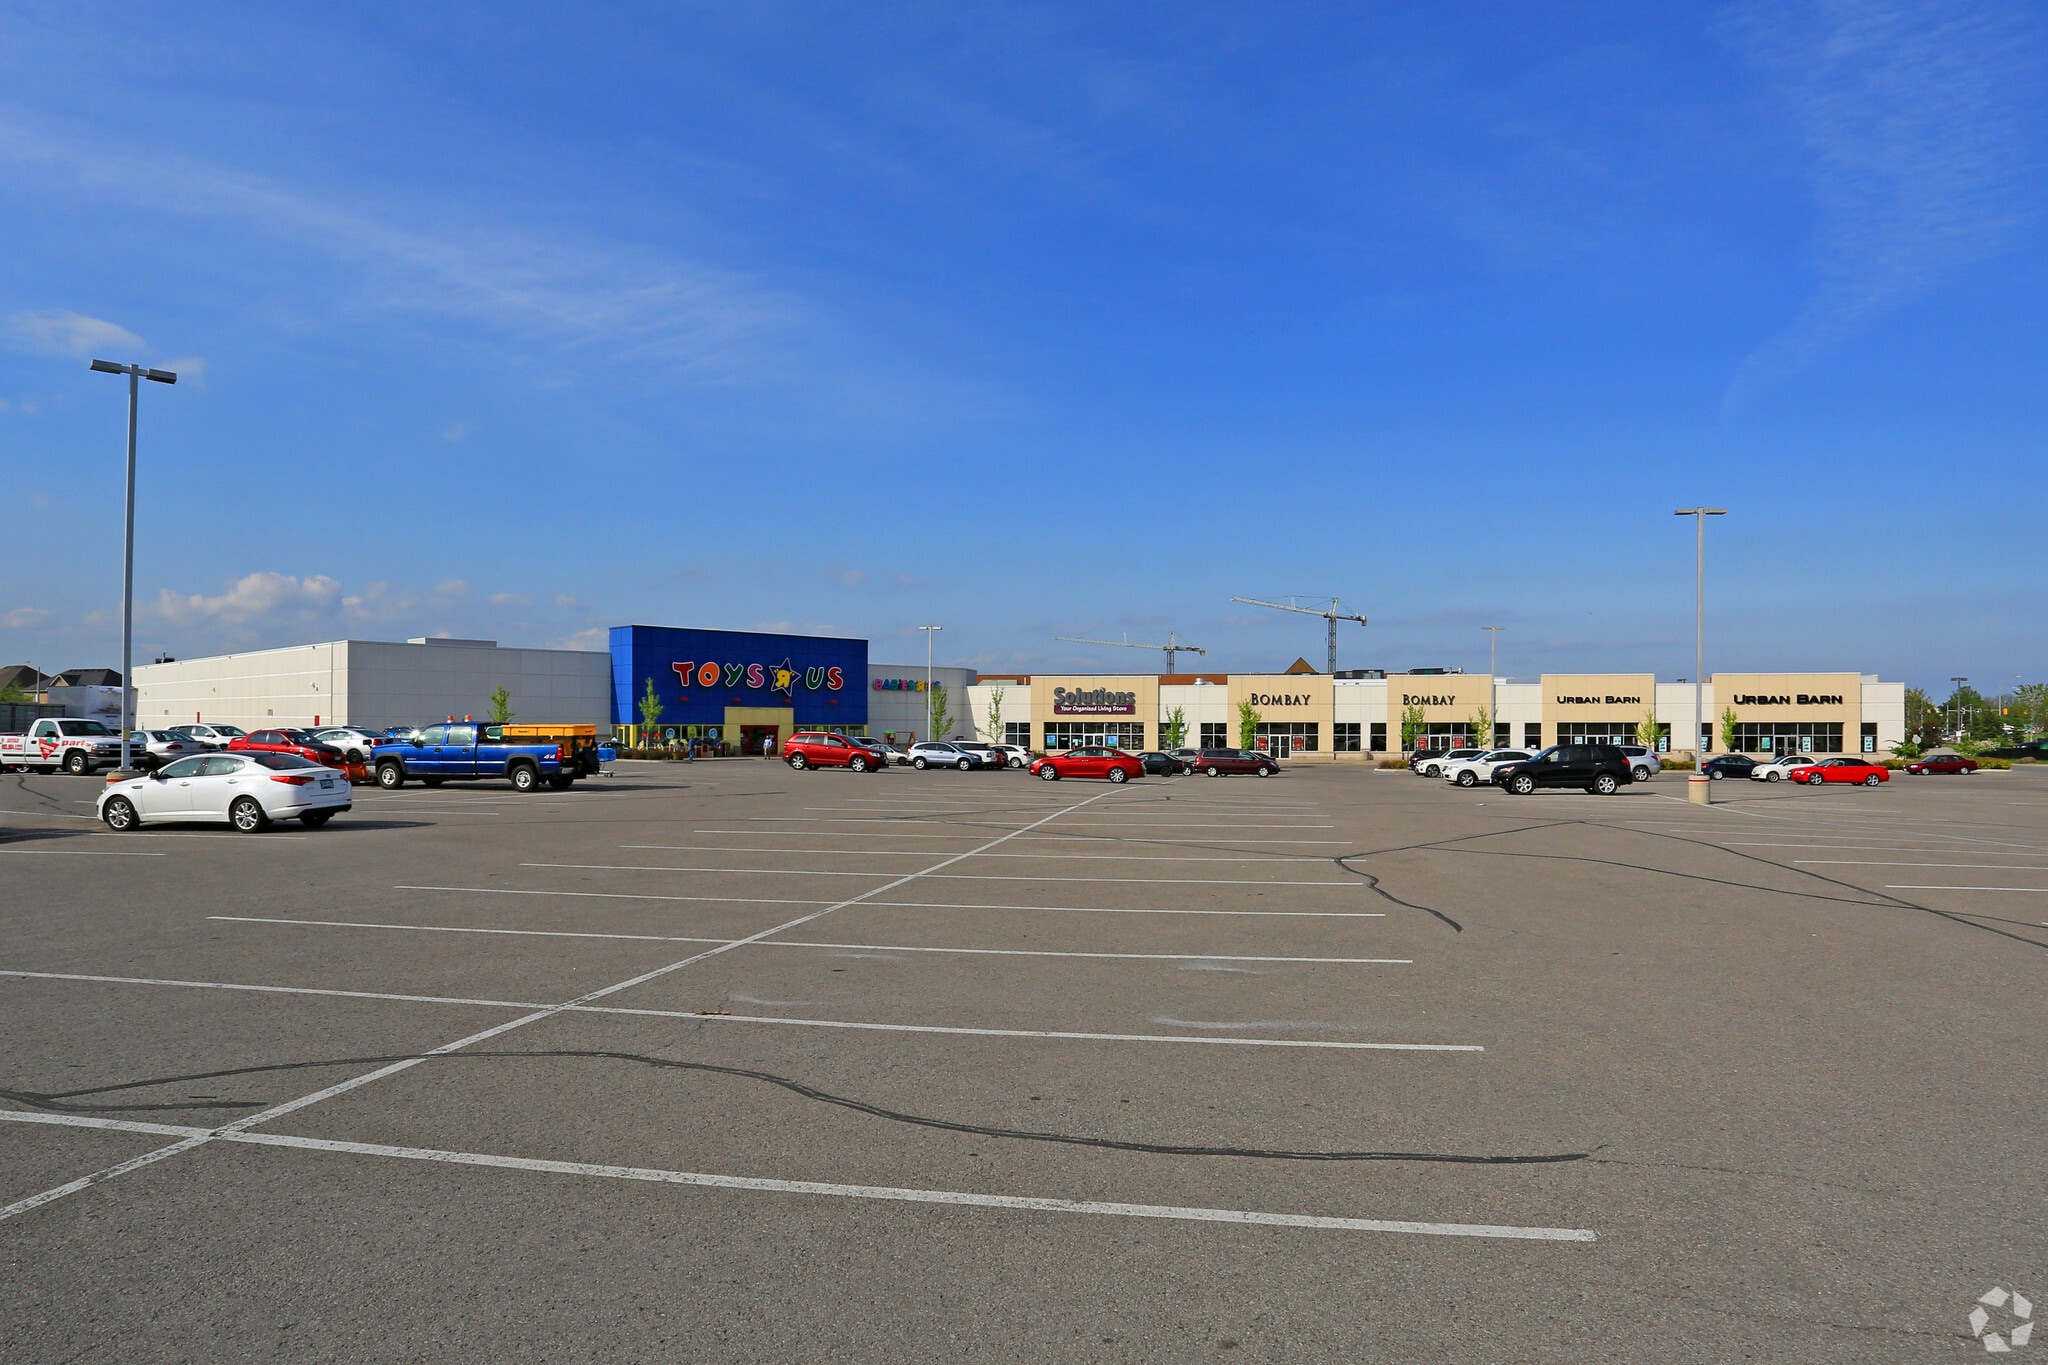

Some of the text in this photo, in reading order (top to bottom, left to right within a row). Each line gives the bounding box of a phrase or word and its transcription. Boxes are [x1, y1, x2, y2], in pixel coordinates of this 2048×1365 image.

[672, 661, 765, 688] TOYS
[805, 666, 844, 691] US
[1054, 687, 1136, 705] Solutions
[1250, 693, 1311, 706] BOMBAY
[1402, 694, 1456, 706] BOMBAY
[1556, 695, 1641, 704] URBAN BARN
[1733, 694, 1844, 705] URBAN BARN
